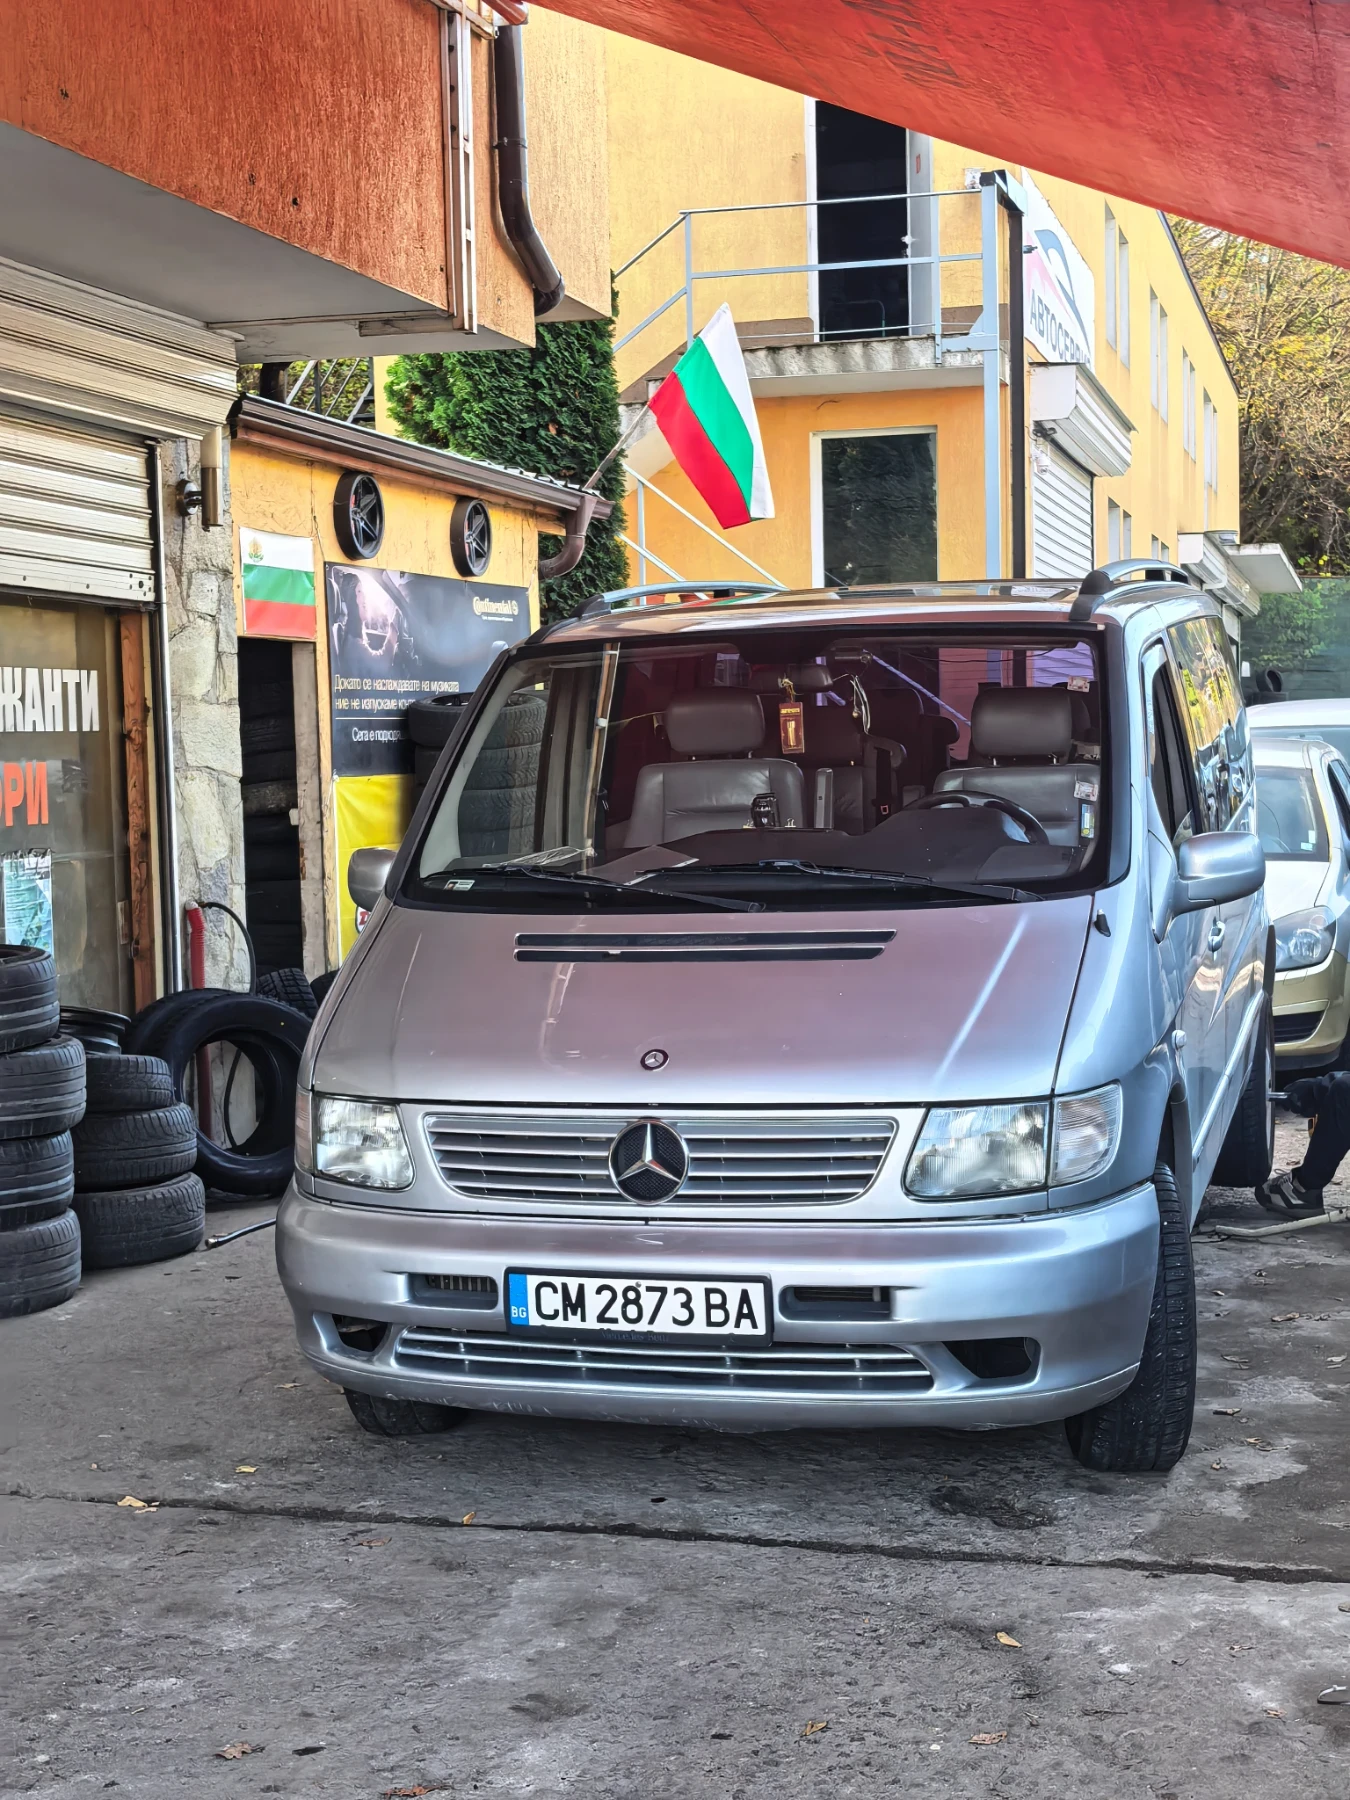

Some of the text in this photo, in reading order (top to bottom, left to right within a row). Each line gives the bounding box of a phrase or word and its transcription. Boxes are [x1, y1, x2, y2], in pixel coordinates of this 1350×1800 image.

[334, 674, 361, 692] Докато
[363, 678, 372, 690] се
[373, 679, 420, 693] наслаждавате
[421, 680, 430, 691] на
[335, 698, 349, 709] ние
[351, 698, 360, 709] не
[361, 698, 397, 713] изпускаме
[352, 727, 369, 741] Сега
[369, 730, 374, 741] е
[0, 761, 49, 827] РИ
[511, 1306, 527, 1318] BG
[534, 1281, 758, 1329] CM 2873 BA
